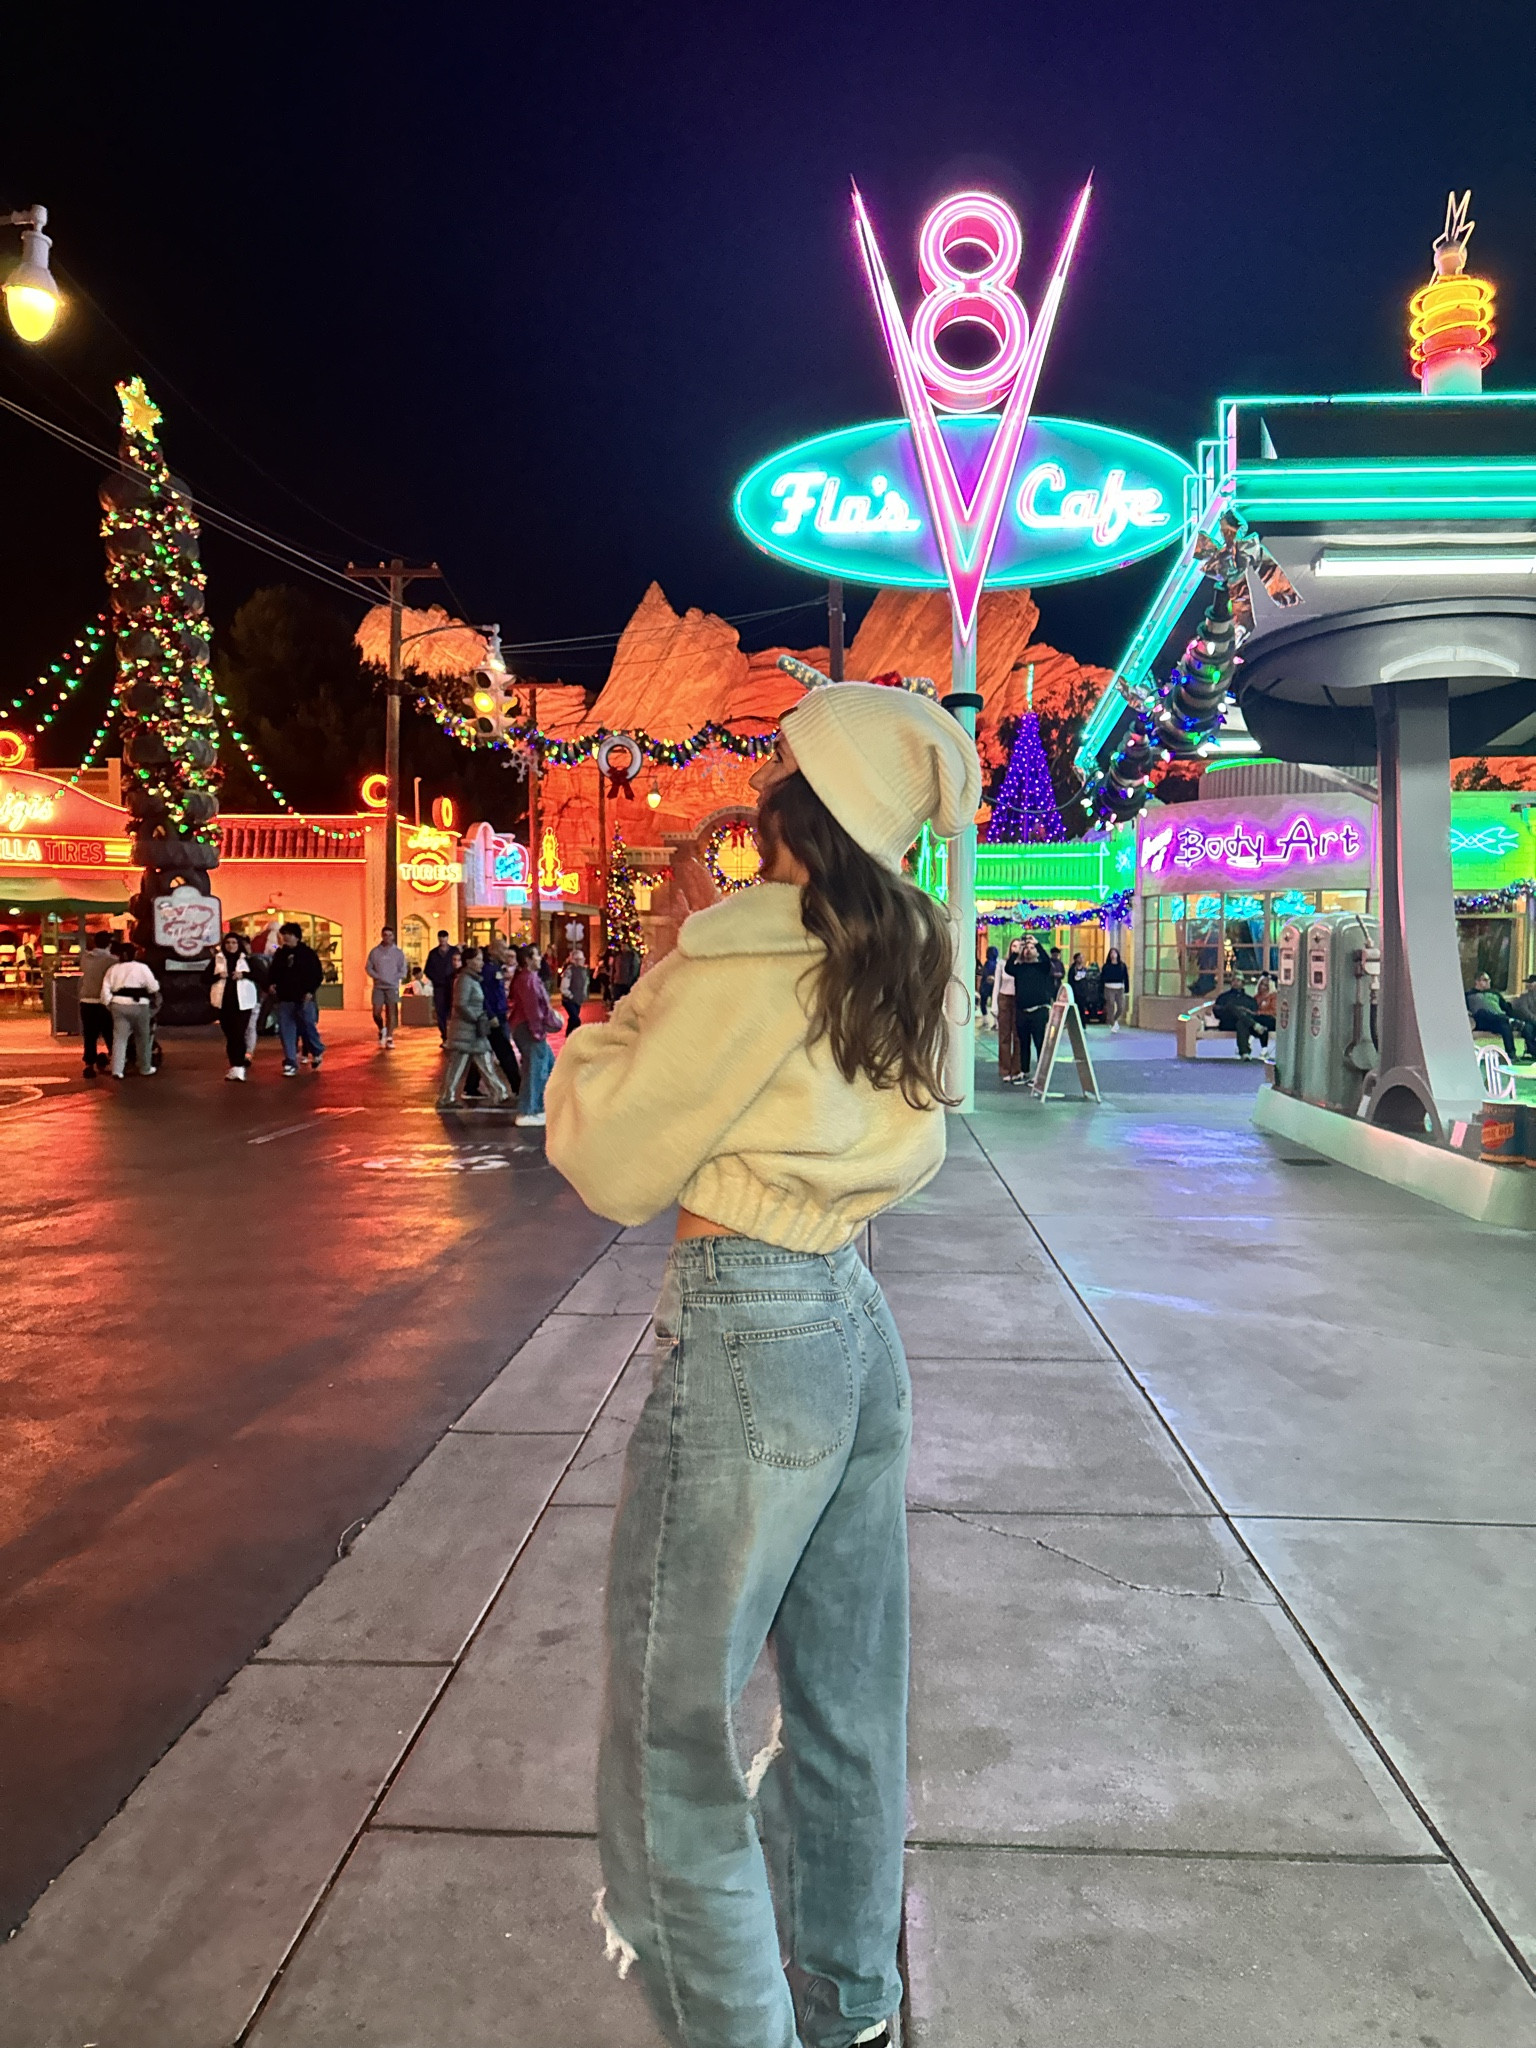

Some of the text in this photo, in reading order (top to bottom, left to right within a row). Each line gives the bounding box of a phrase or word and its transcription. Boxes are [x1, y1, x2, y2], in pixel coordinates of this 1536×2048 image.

[770, 463, 1172, 548] Flo's Cafe
[44, 840, 104, 864] TIRES
[1174, 825, 1265, 869] Body
[1276, 817, 1362, 862] Art
[399, 863, 462, 883] TIRES
